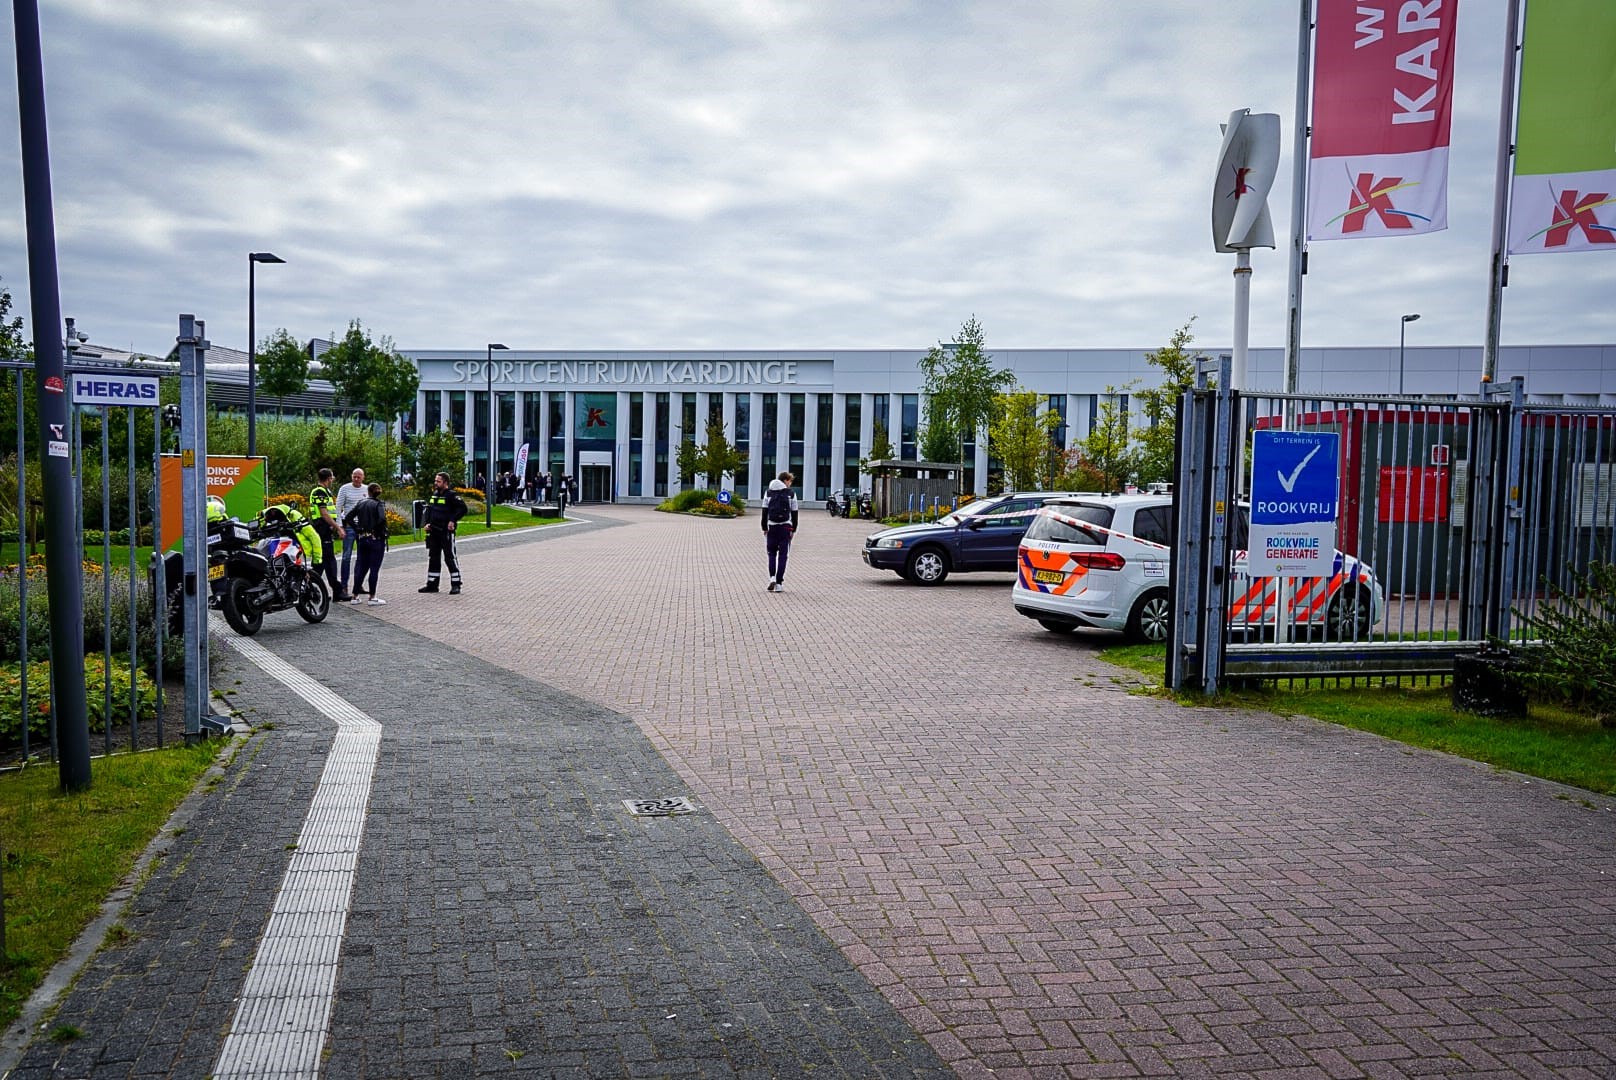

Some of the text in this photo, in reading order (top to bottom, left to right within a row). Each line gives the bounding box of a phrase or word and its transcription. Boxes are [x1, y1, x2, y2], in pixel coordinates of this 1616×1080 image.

[1354, 0, 1384, 49] W
[453, 361, 798, 384] SPORTCENTRUM KARDINGE
[76, 380, 156, 399] HERAS
[207, 467, 241, 476] DINGE
[207, 476, 235, 486] RECA
[1257, 501, 1330, 514] ROOKVRIJ
[1038, 542, 1061, 550] POLITIE
[1266, 537, 1319, 548] ROOKVRIJE
[1266, 548, 1319, 559] GENERATIE
